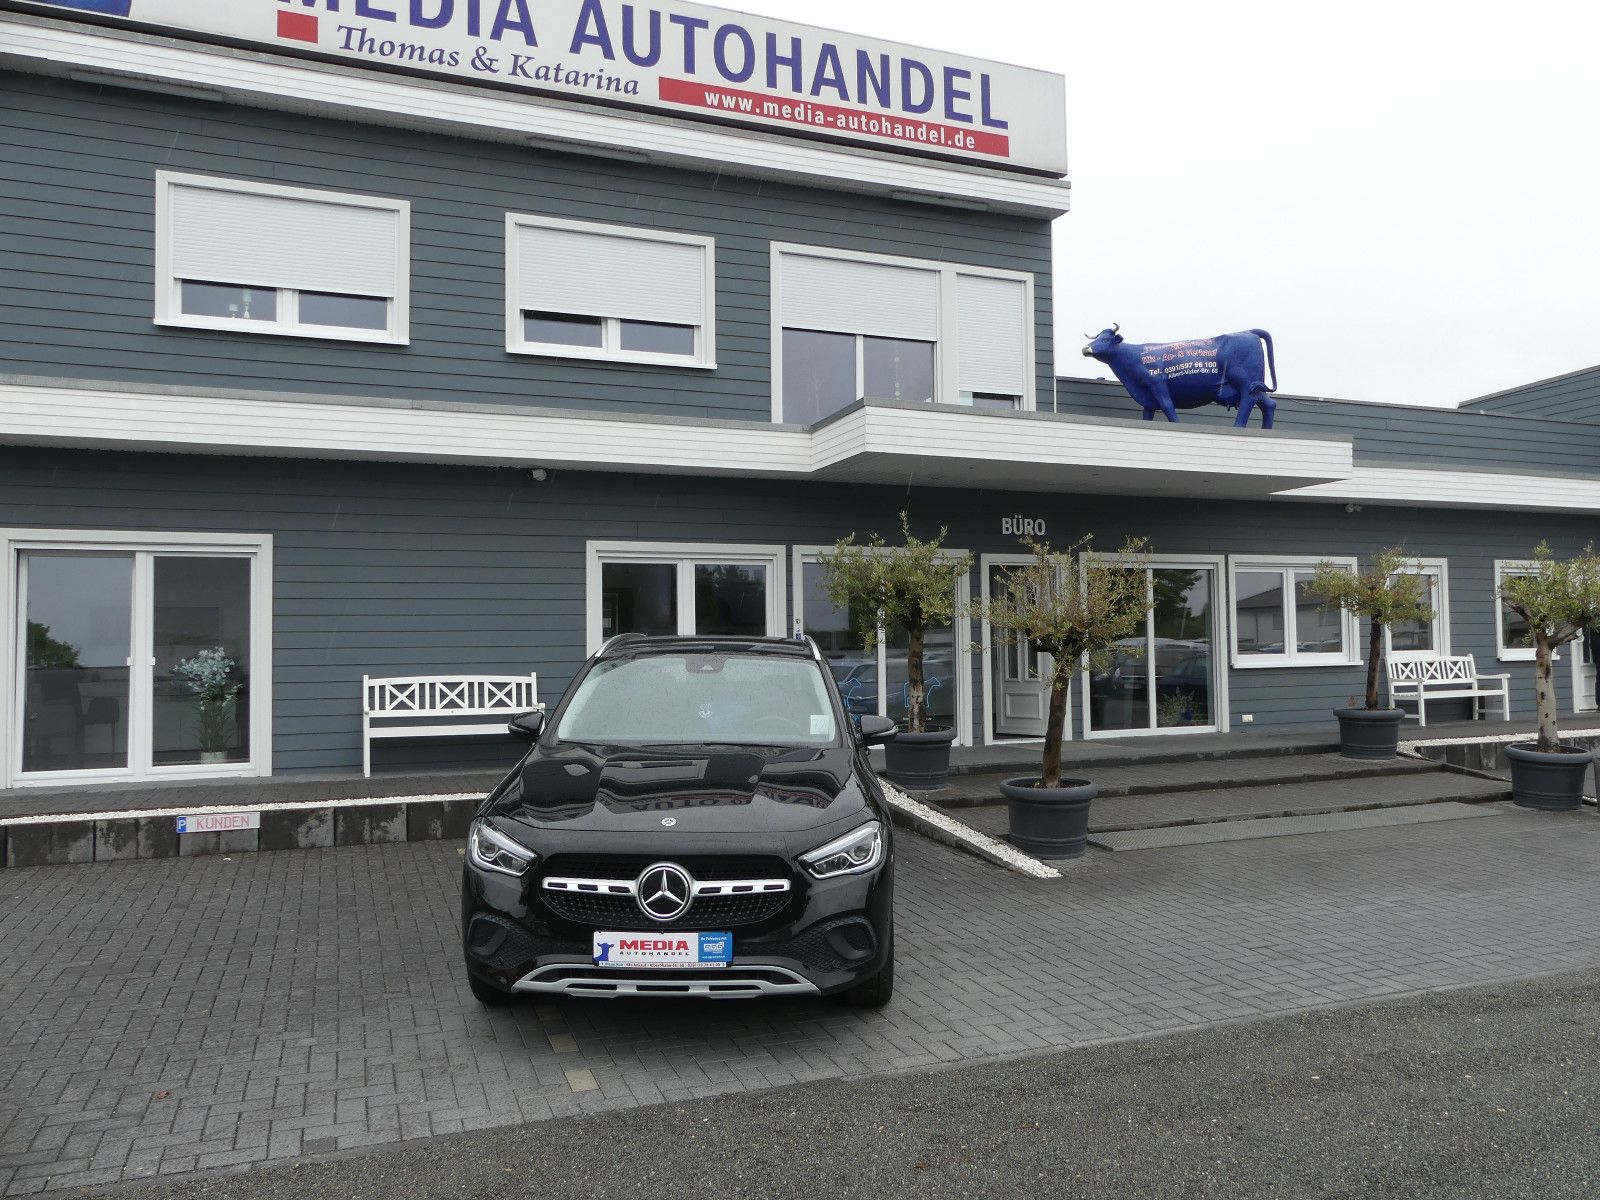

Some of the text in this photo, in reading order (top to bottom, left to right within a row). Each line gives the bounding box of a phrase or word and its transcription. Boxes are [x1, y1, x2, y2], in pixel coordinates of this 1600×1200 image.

[337, 24, 640, 96] Thomas & Katarina
[569, 0, 1008, 130] AUTOHANDEL
[704, 89, 976, 150] www.media-autohandel.de
[1149, 368, 1162, 376] Tel.
[1002, 515, 1046, 535] BÜRO
[197, 816, 249, 830] KUNDEN
[620, 940, 689, 950] MEDIA
